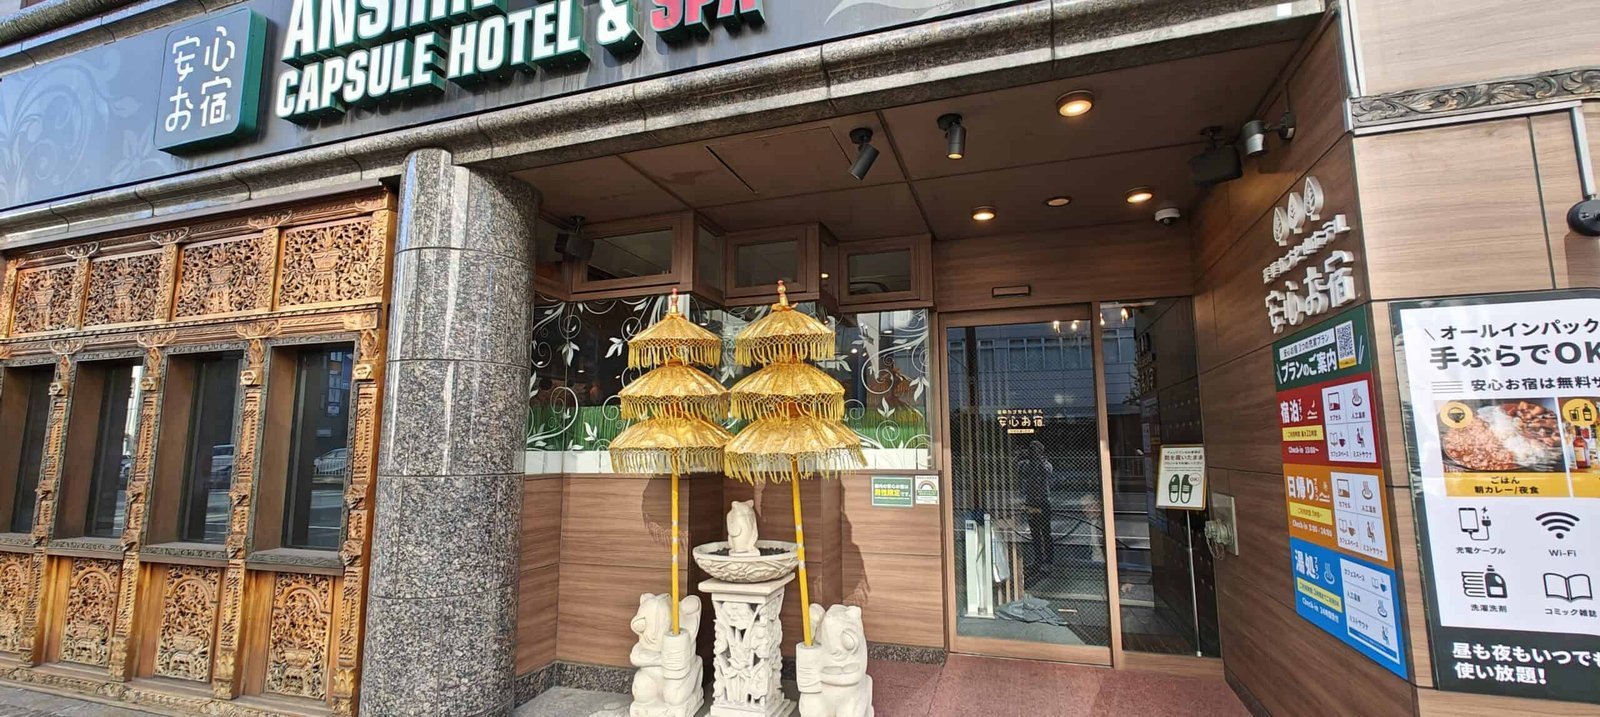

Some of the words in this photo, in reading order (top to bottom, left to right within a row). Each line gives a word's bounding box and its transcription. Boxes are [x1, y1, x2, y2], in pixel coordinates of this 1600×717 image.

[171, 26, 236, 82] 安心
[275, 31, 436, 119] CAPSULE
[447, 0, 582, 81] HOTEL
[596, 0, 632, 46] &
[164, 75, 232, 132] お宿
[1265, 250, 1356, 335] 安心お宿
[1440, 317, 1599, 341] オールインパック
[1280, 348, 1338, 383] プランのご案内
[996, 415, 1045, 428] 安心お宿
[1280, 400, 1300, 424] 宿泊
[1287, 475, 1315, 501] 日帰り
[1490, 476, 1520, 485] ごはん
[1455, 547, 1506, 556] 充電ケーブル
[1548, 549, 1577, 557] Wi-Fi
[1470, 604, 1508, 613] 洗濯洗剤
[1544, 607, 1598, 618] コミック雑誌
